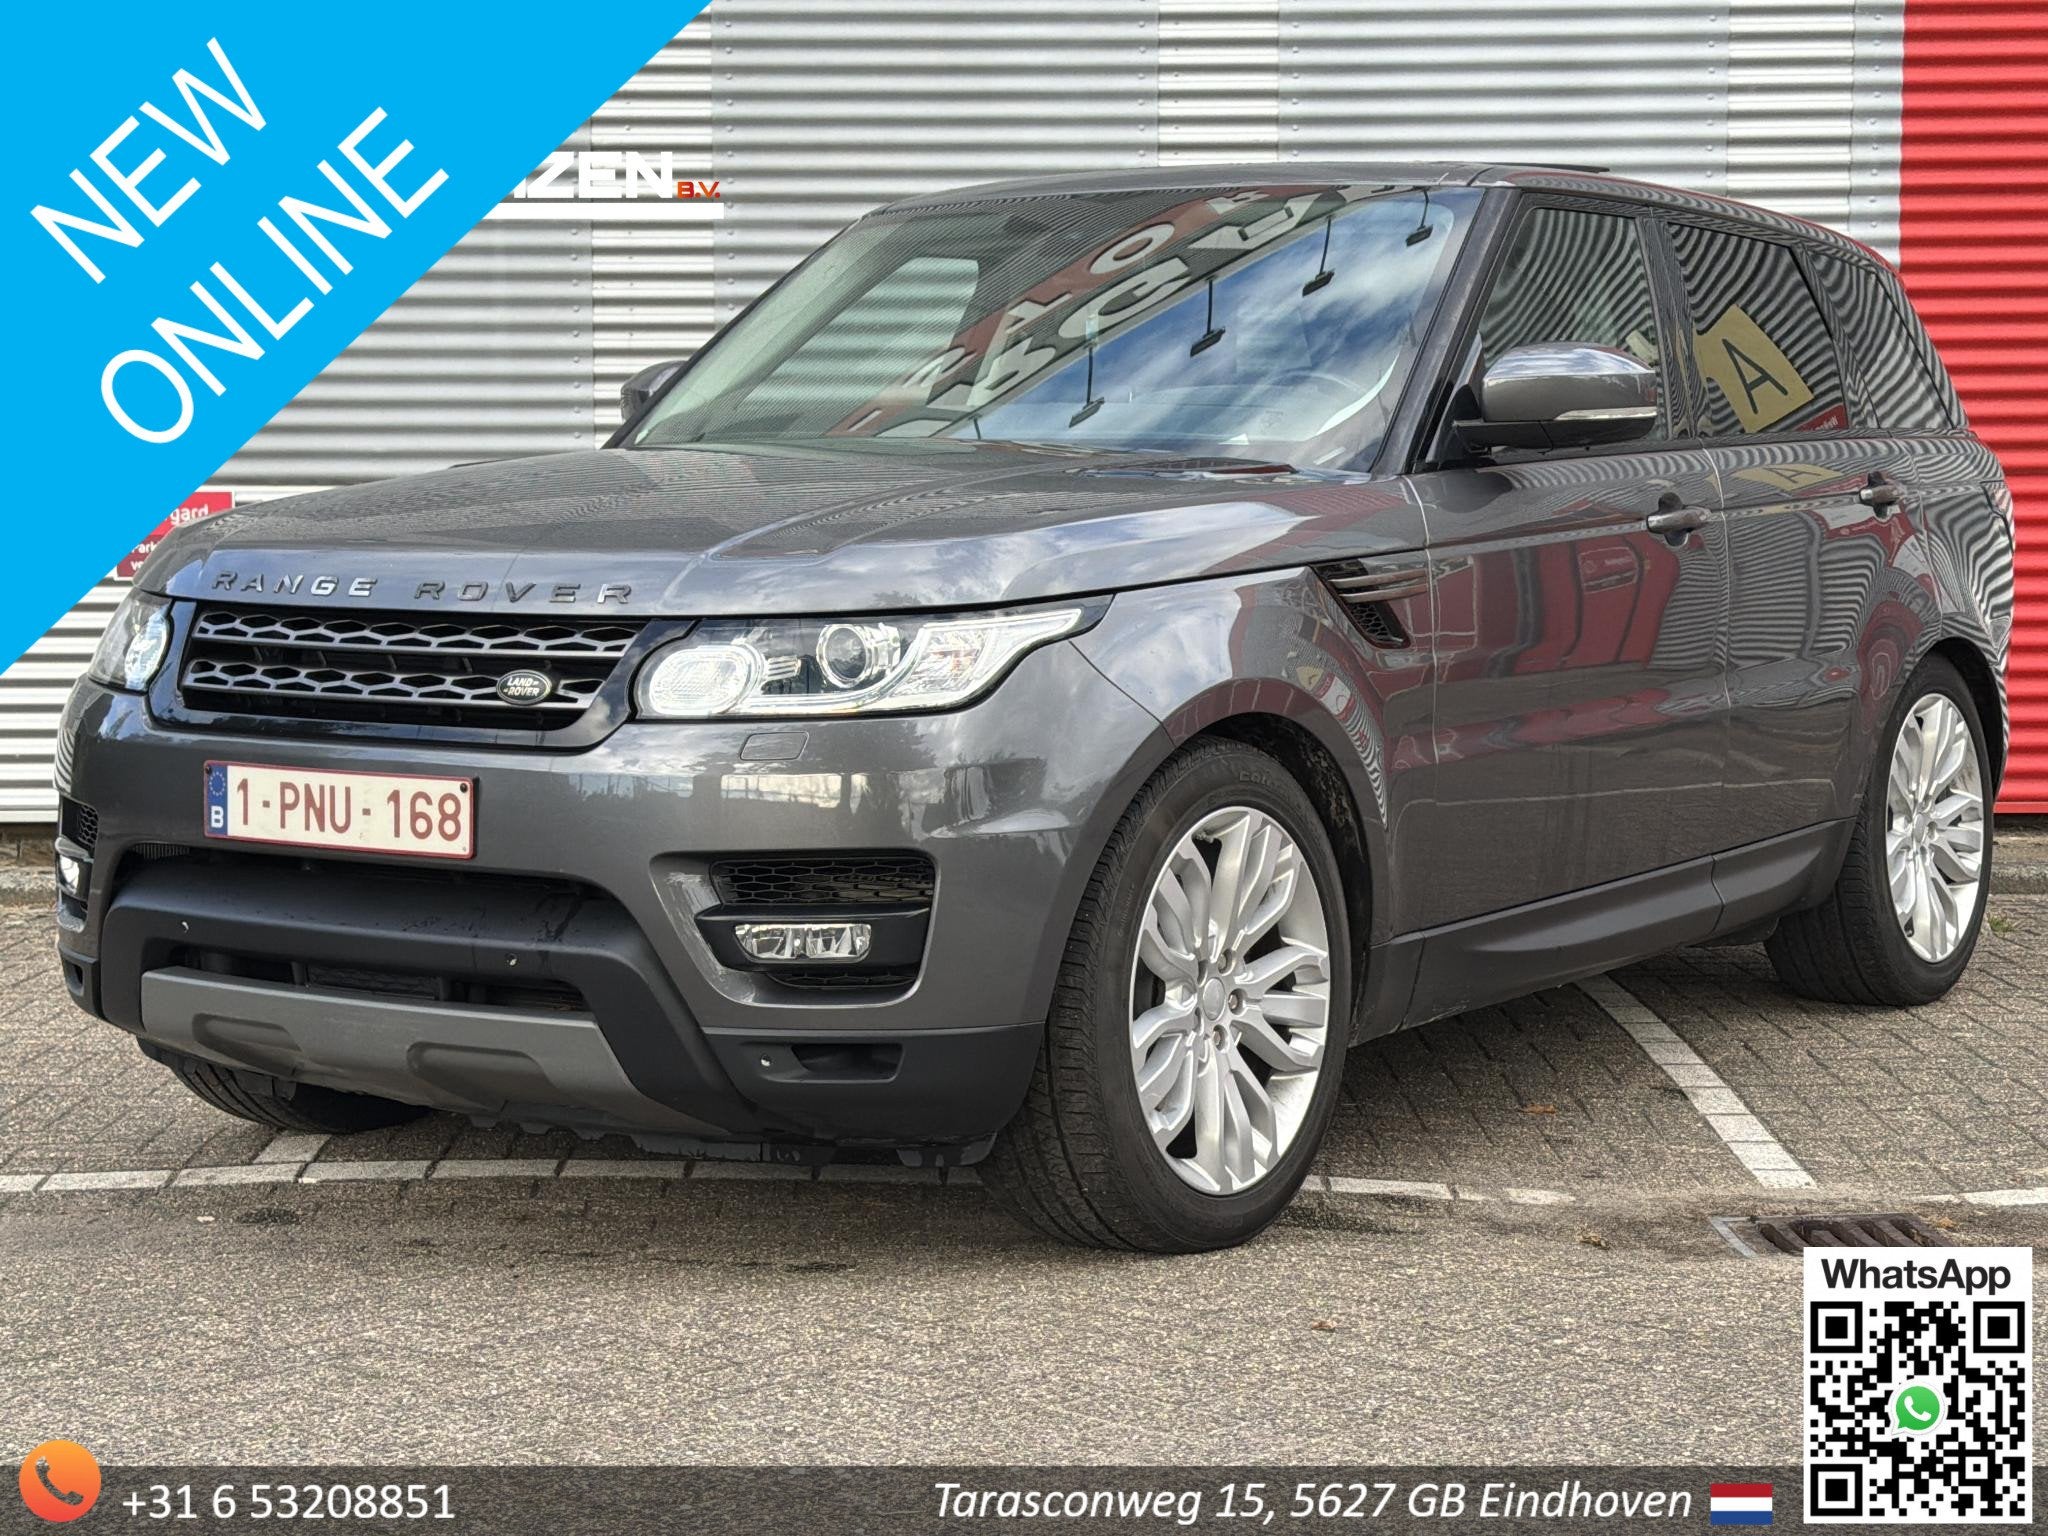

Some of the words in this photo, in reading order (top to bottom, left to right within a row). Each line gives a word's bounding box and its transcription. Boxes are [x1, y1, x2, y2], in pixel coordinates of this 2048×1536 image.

[211, 571, 378, 598] RANGE
[414, 581, 632, 604] ROVER
[211, 805, 224, 828] B
